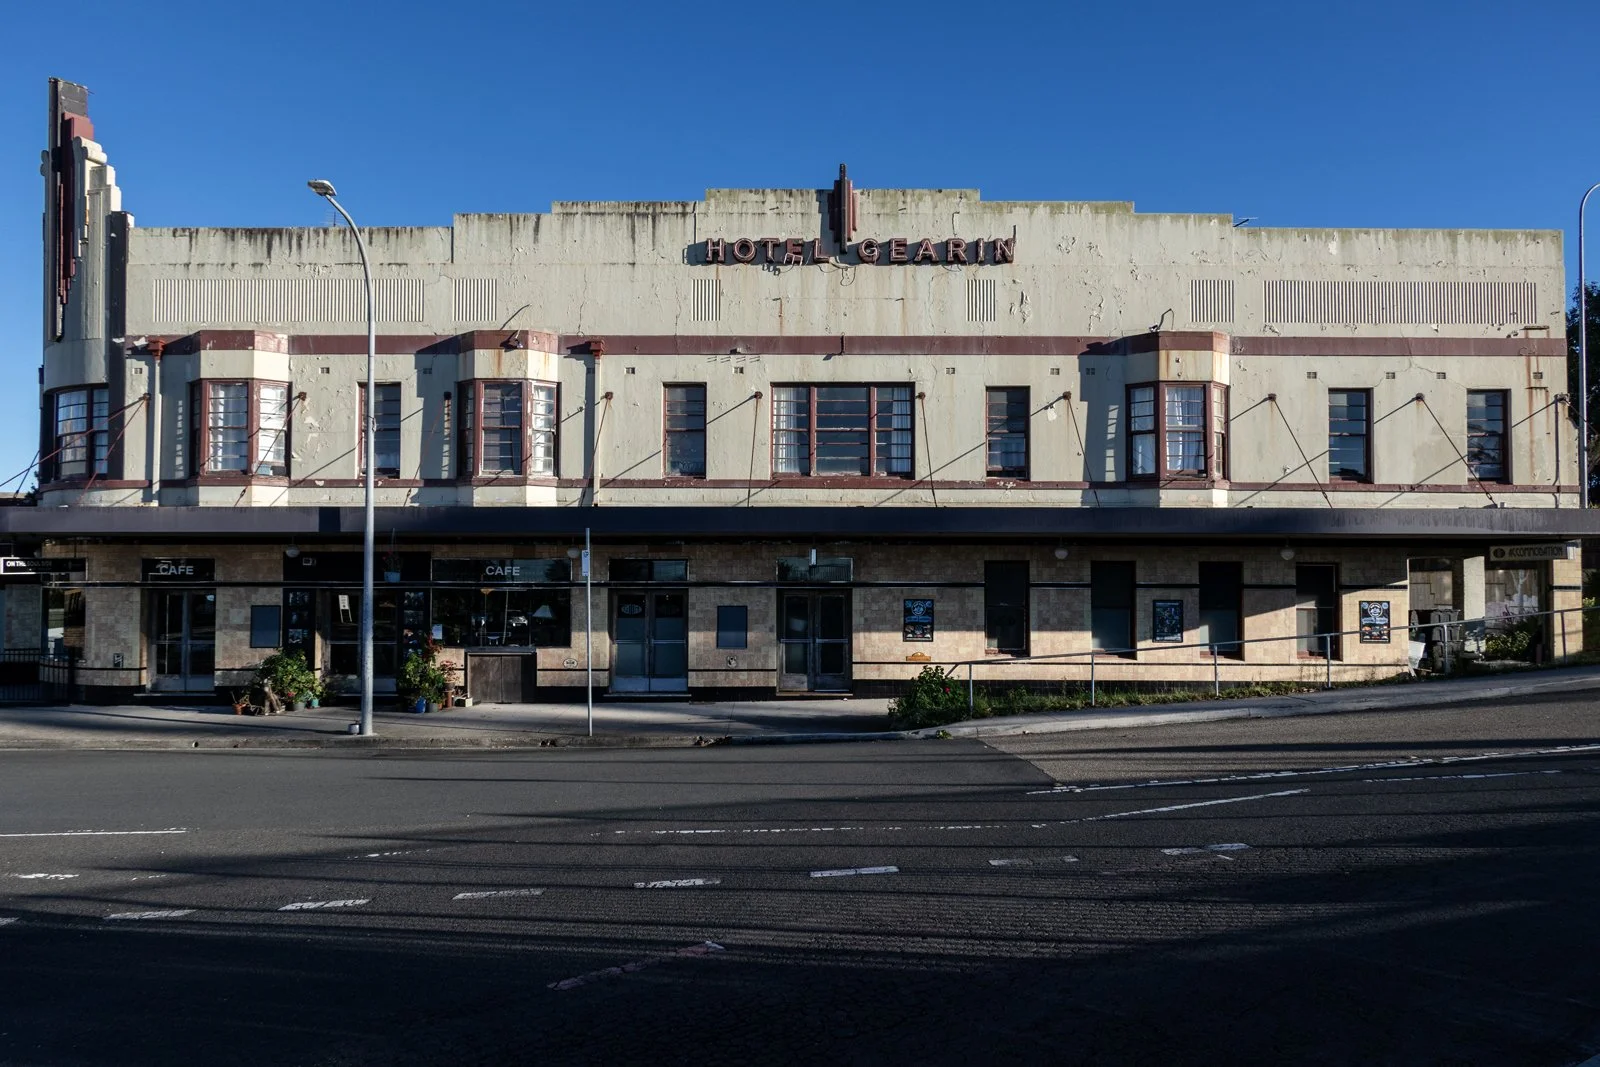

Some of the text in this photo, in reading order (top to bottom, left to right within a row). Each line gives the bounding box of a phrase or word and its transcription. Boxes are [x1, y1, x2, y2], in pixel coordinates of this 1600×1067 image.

[706, 237, 1015, 262] HOTEL GEARIN
[160, 565, 194, 575] CAFE
[486, 565, 520, 576] CAFE
